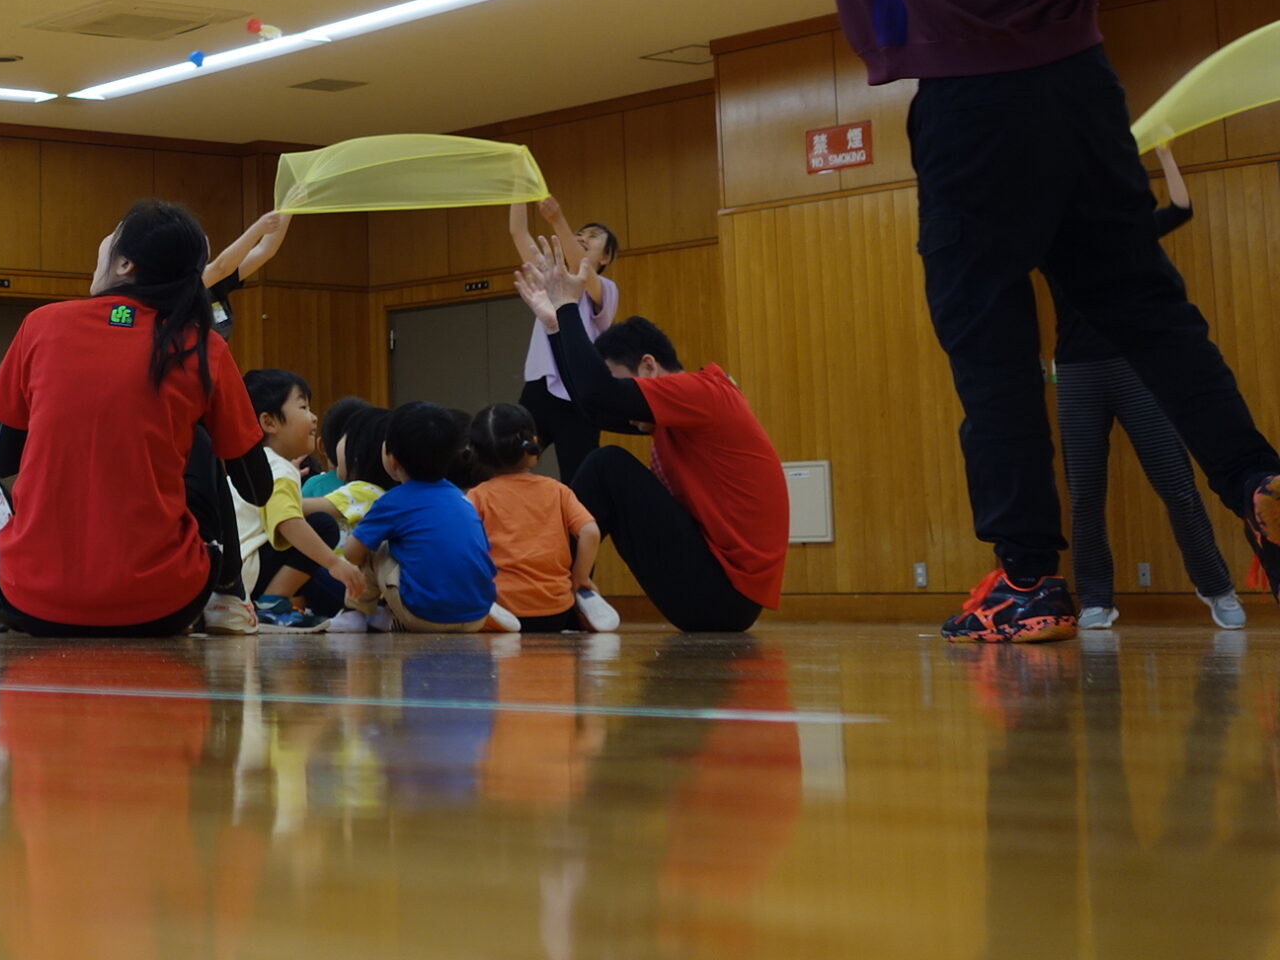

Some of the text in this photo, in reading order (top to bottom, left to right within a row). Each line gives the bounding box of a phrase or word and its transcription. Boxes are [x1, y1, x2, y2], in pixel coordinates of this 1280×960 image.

[812, 127, 864, 155] 禁煙
[811, 150, 866, 168] NO SMOKING
